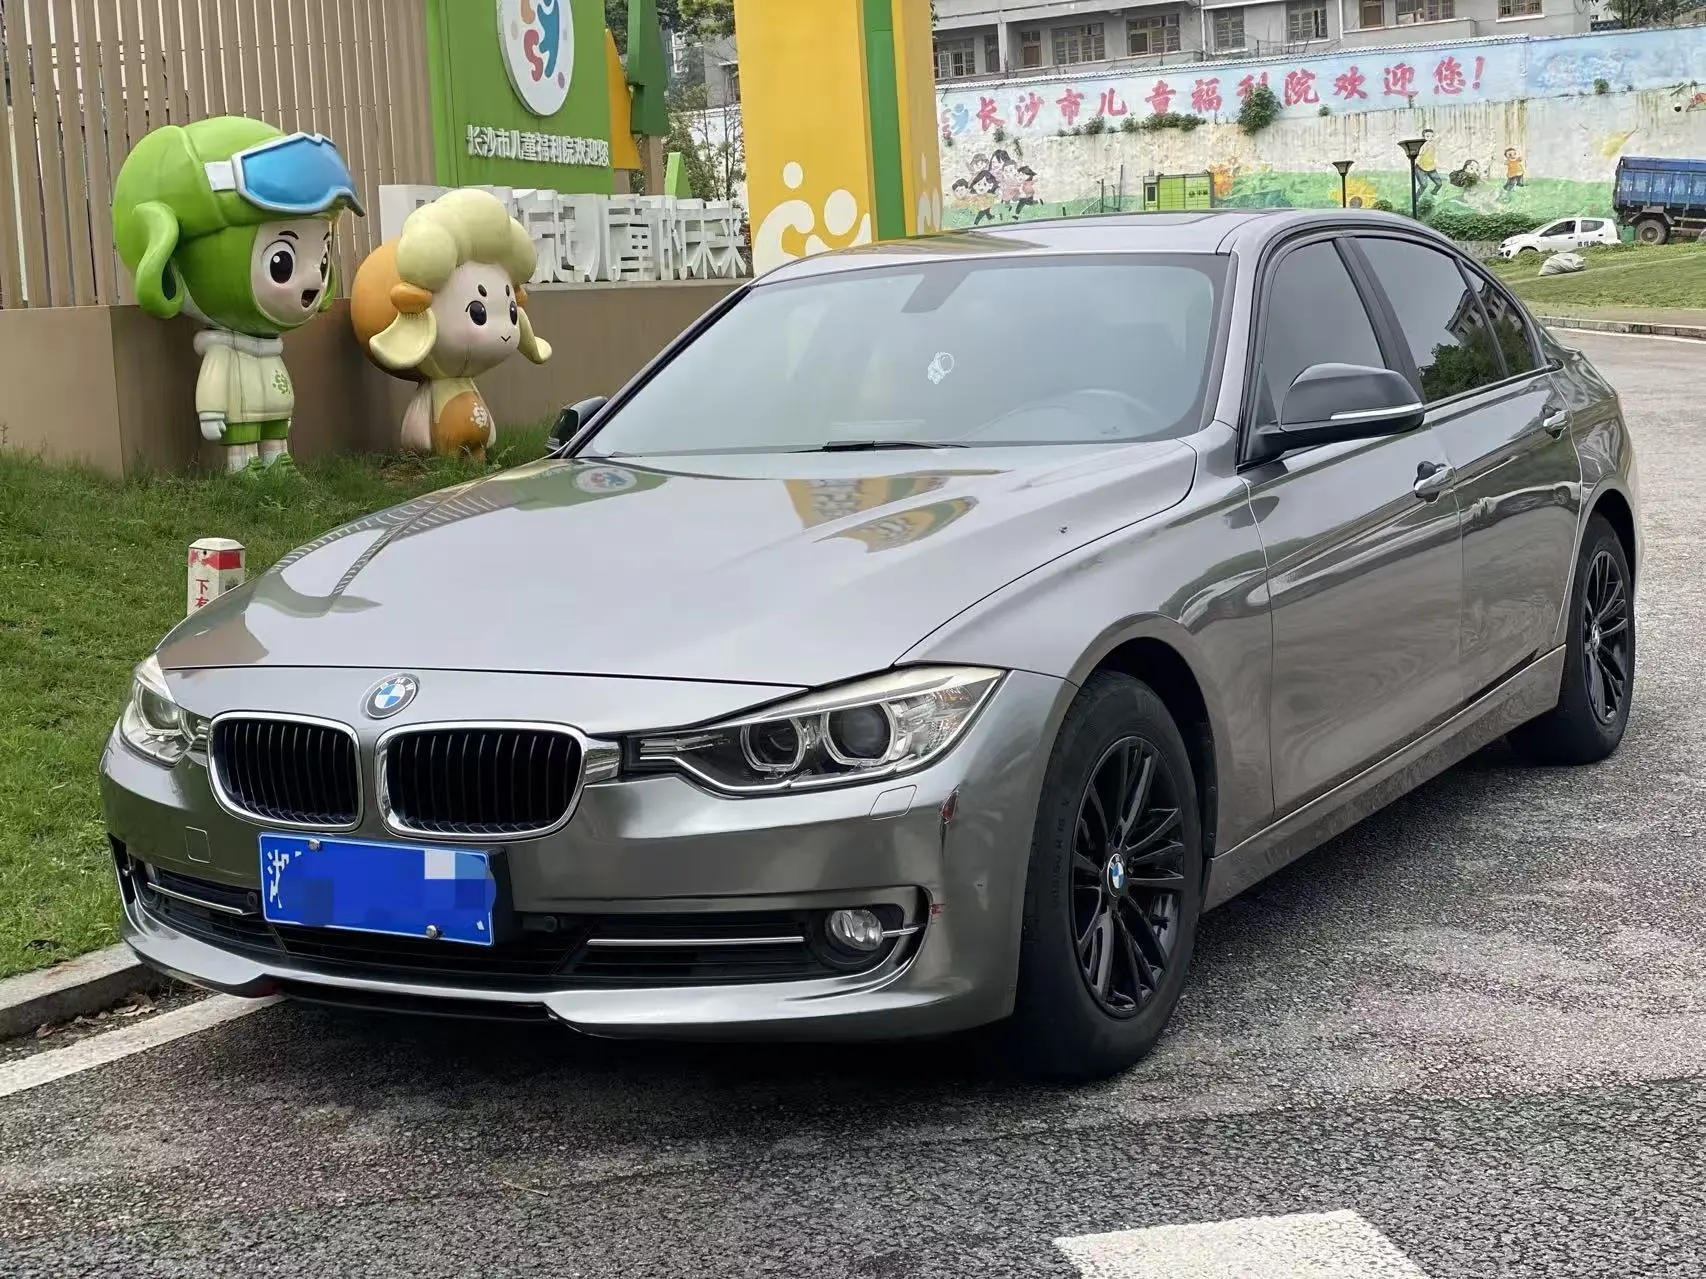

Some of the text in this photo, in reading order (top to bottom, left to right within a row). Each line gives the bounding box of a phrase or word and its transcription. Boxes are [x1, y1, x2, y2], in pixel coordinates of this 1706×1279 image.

[466, 125, 609, 167] 长沙市儿童福利院欢迎您
